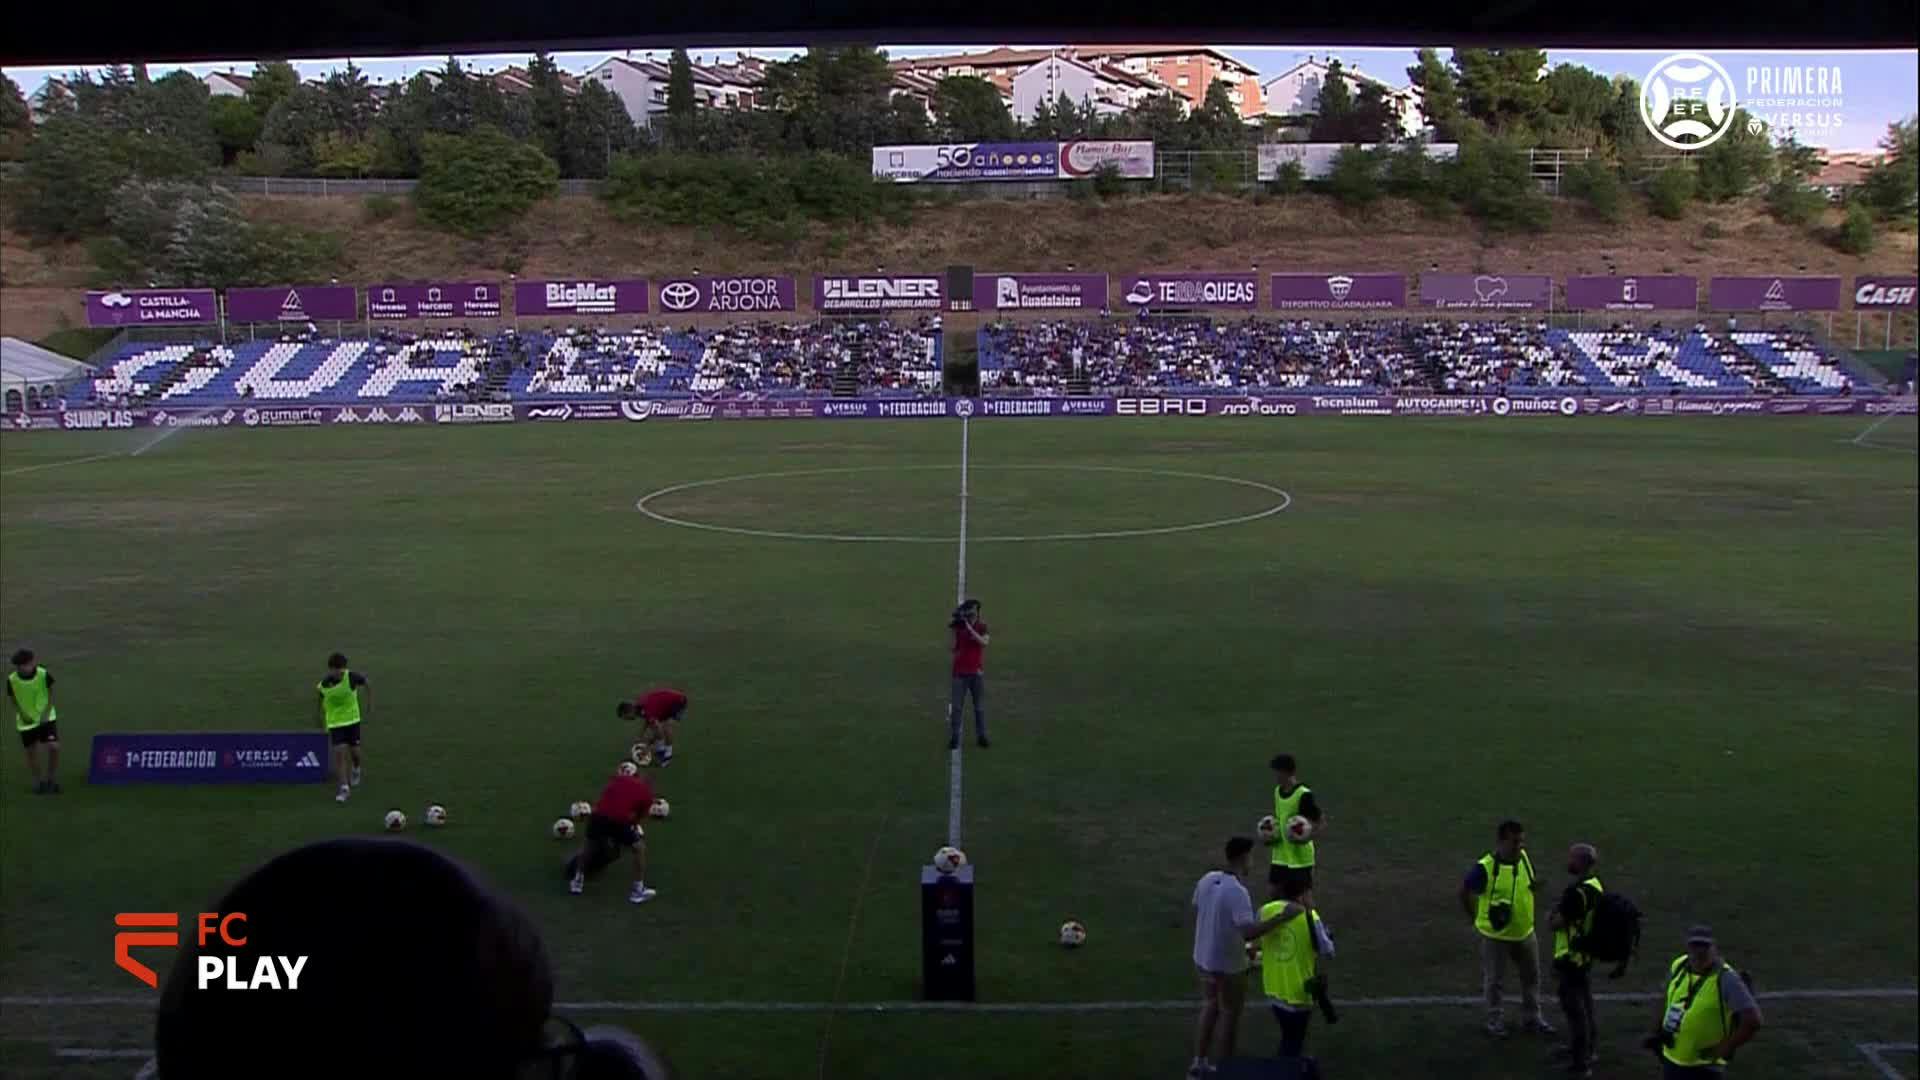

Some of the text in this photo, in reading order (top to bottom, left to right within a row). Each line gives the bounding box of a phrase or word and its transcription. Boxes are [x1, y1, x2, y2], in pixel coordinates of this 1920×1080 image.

[936, 147, 972, 167] 50
[711, 279, 777, 294] MOTOR
[842, 279, 941, 298] LENER
[546, 283, 617, 306] BigMat
[1021, 294, 1081, 308] Guadalajara
[1856, 283, 1917, 305] CASH
[708, 295, 782, 311] ARJONA
[824, 299, 880, 309] DESARROLLOS
[881, 299, 942, 308] INMOBILIARIOS
[140, 308, 201, 319] LA MANCHA
[1312, 397, 1379, 408] Tecnalum
[1512, 397, 1558, 411] muñoz
[452, 404, 514, 417] LENER
[64, 410, 134, 429] SUINPLAS
[235, 750, 289, 761] VERSUS
